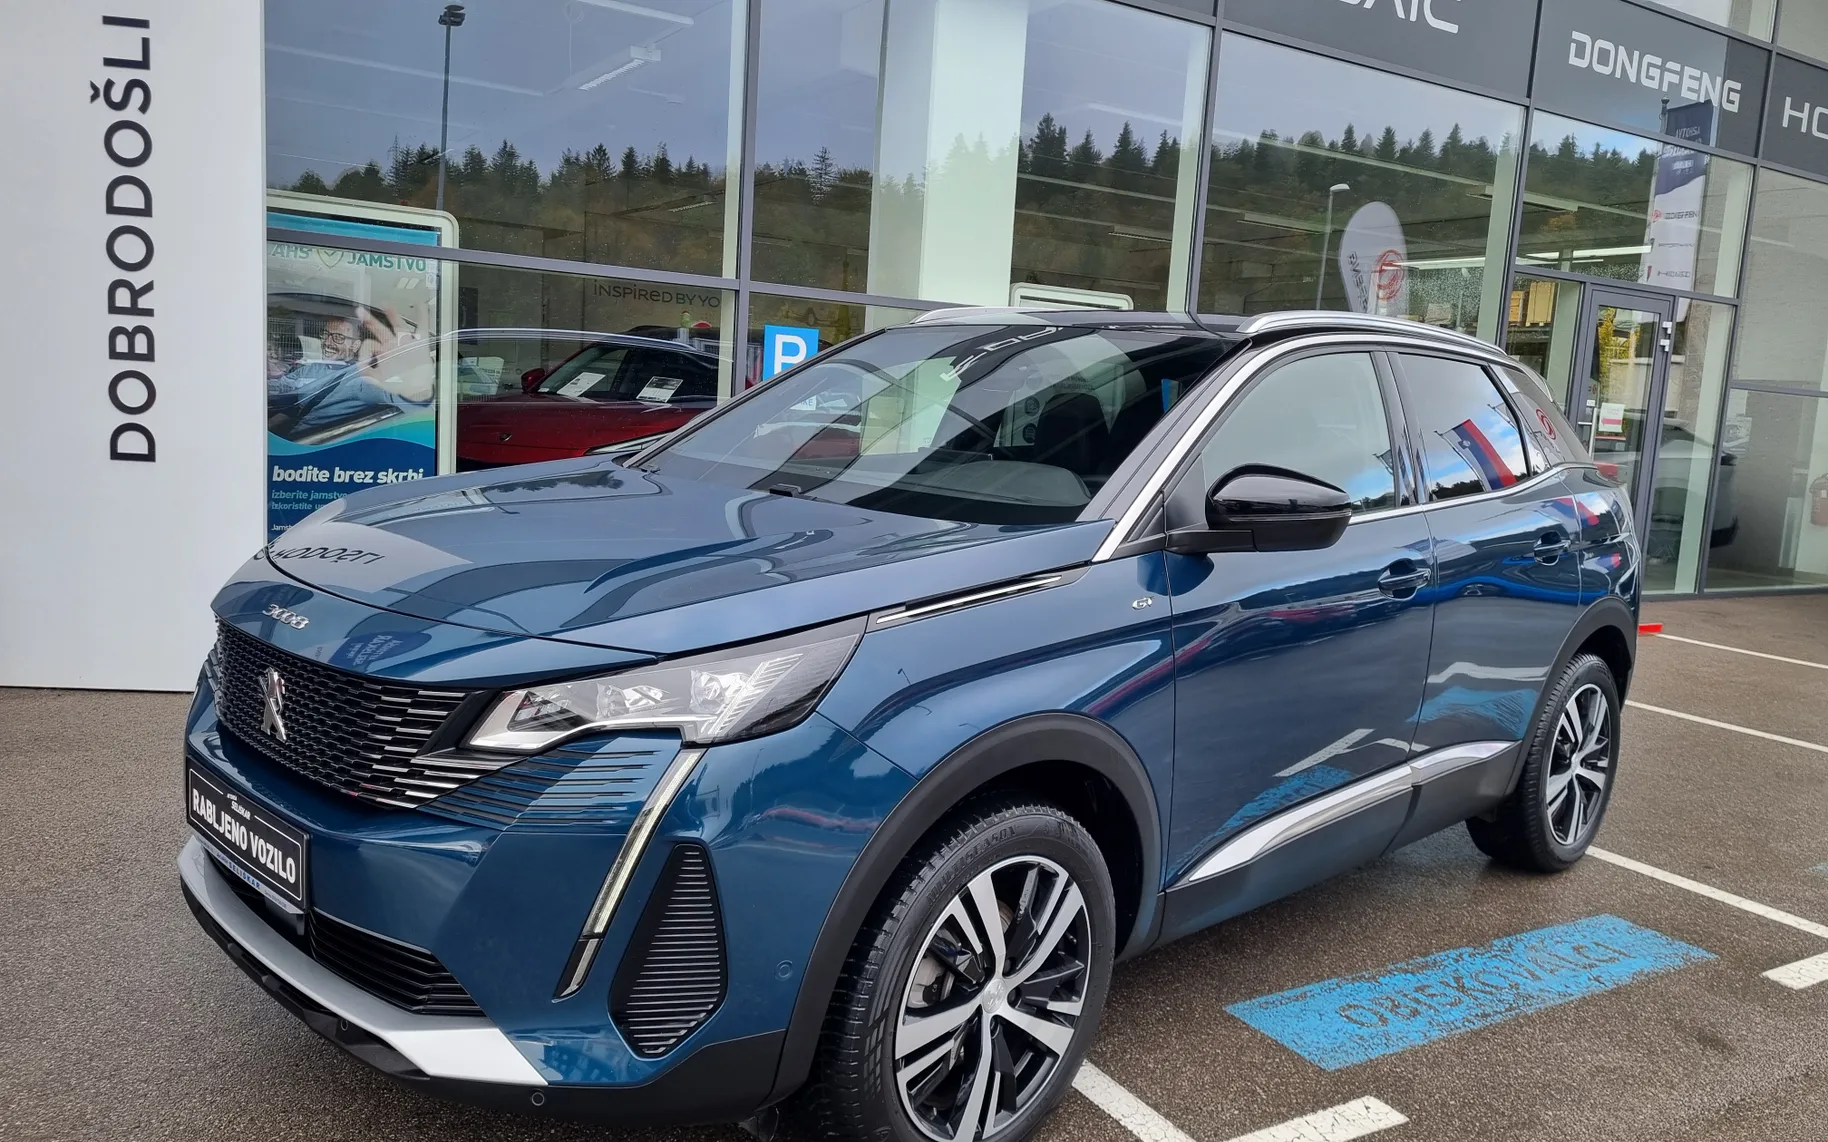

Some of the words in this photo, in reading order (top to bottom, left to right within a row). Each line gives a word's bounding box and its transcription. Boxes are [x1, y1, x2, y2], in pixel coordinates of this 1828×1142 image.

[1568, 30, 1742, 113] DONGFENG
[89, 15, 157, 463] DOBRODOŠLI
[271, 489, 309, 499] izberite
[272, 465, 330, 482] bodite
[333, 467, 375, 484] brez
[262, 603, 311, 630] 3008
[192, 787, 248, 851] RABLJENO
[249, 831, 296, 884] VOZILO
